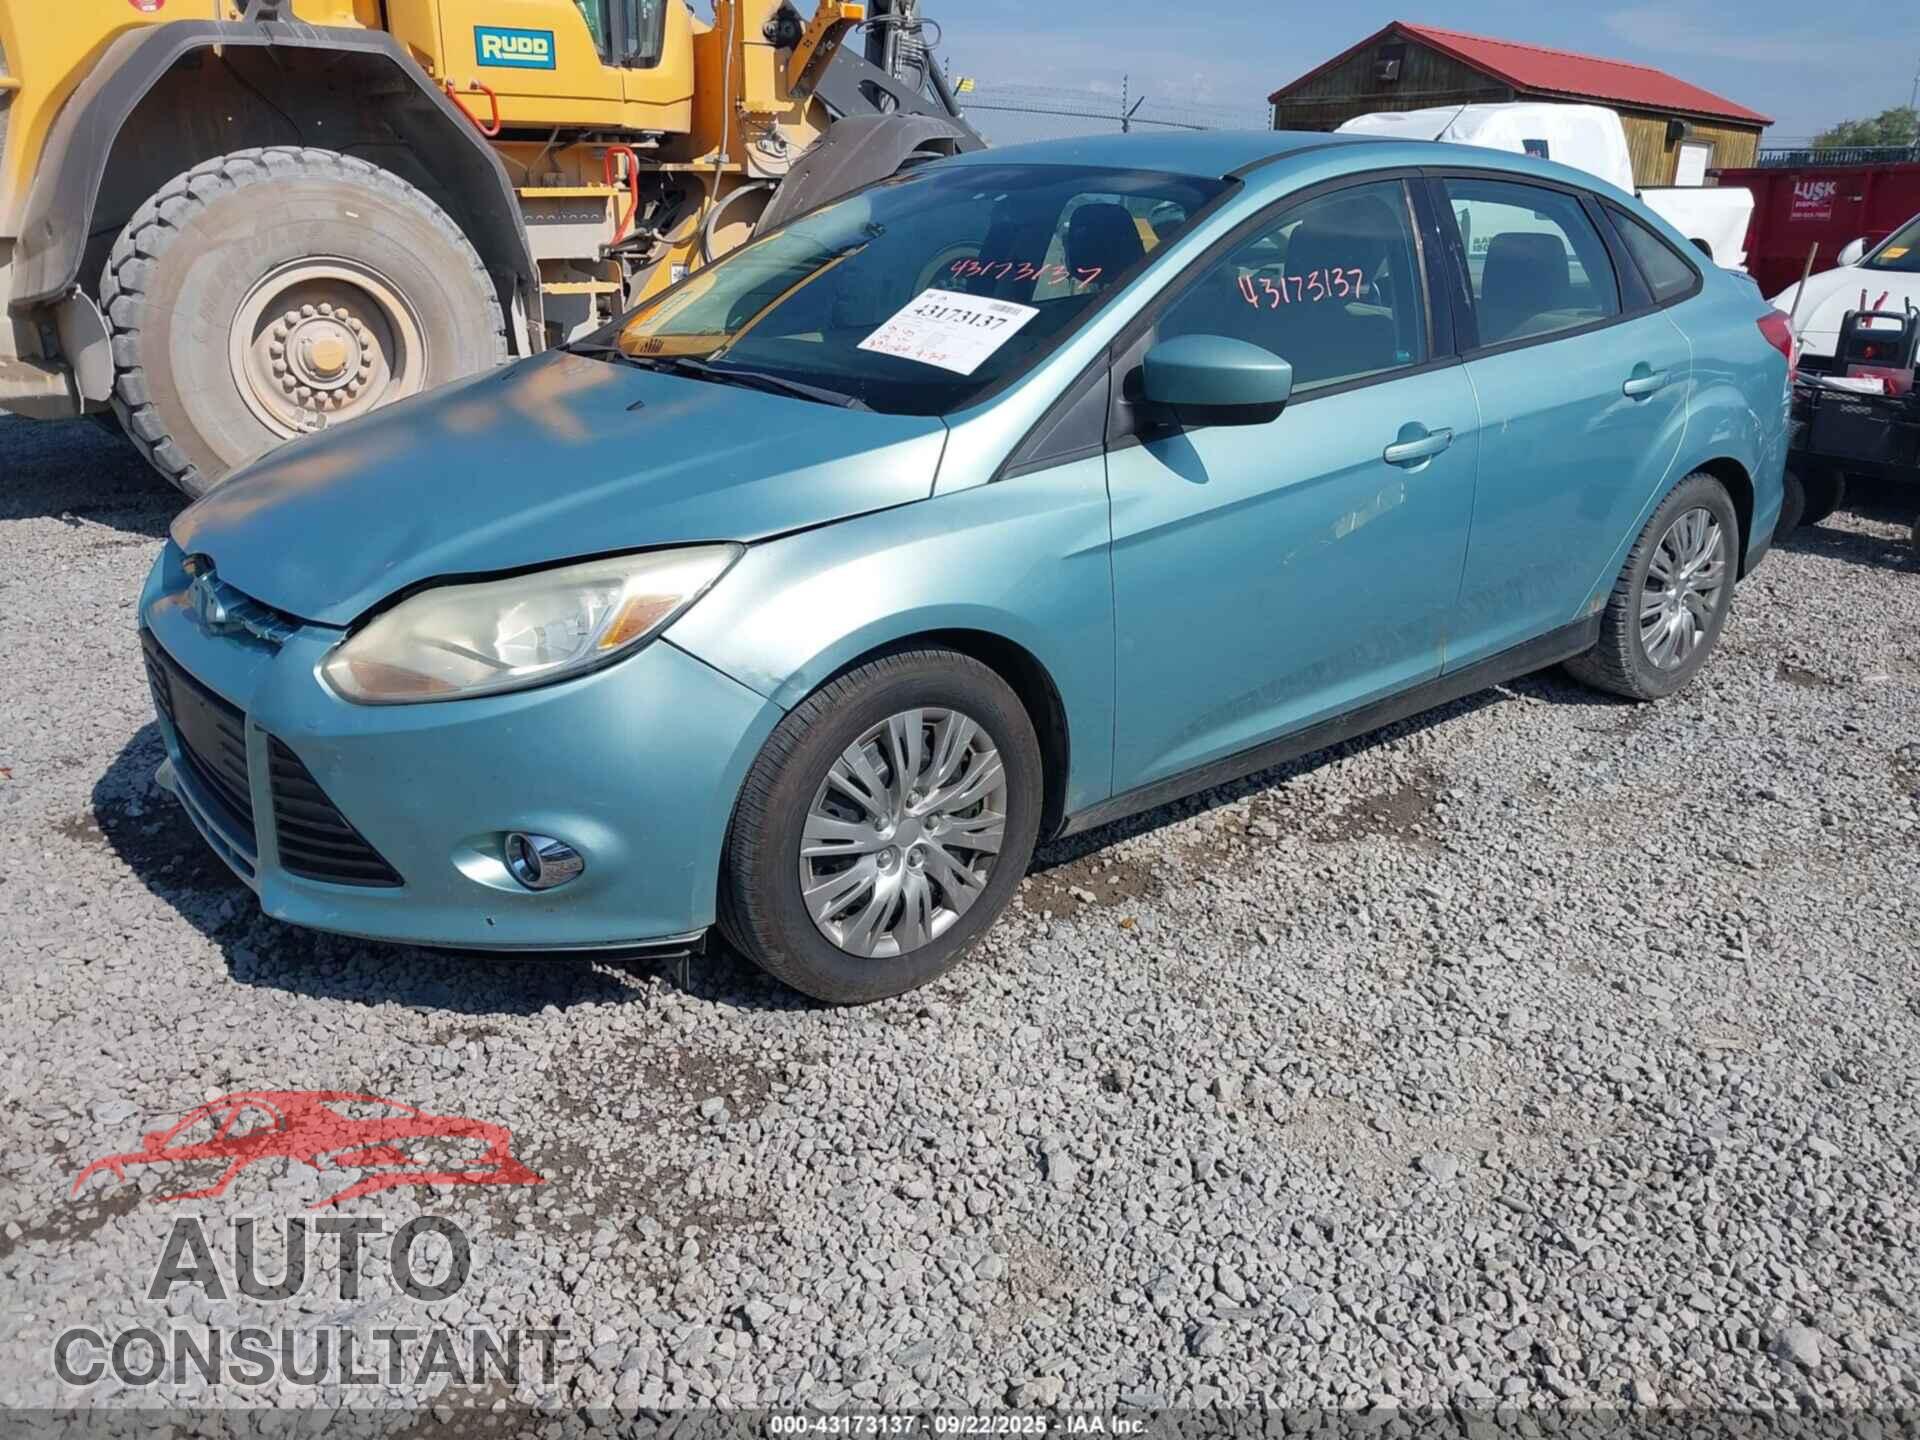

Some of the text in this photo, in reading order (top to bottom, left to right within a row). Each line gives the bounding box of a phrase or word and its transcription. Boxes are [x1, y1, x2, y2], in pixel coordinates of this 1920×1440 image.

[481, 34, 549, 61] RUDD
[1793, 181, 1837, 201] LUSK
[950, 259, 1103, 289] 43173137
[1237, 267, 1364, 309] 43173137
[913, 303, 1008, 331] 43173137
